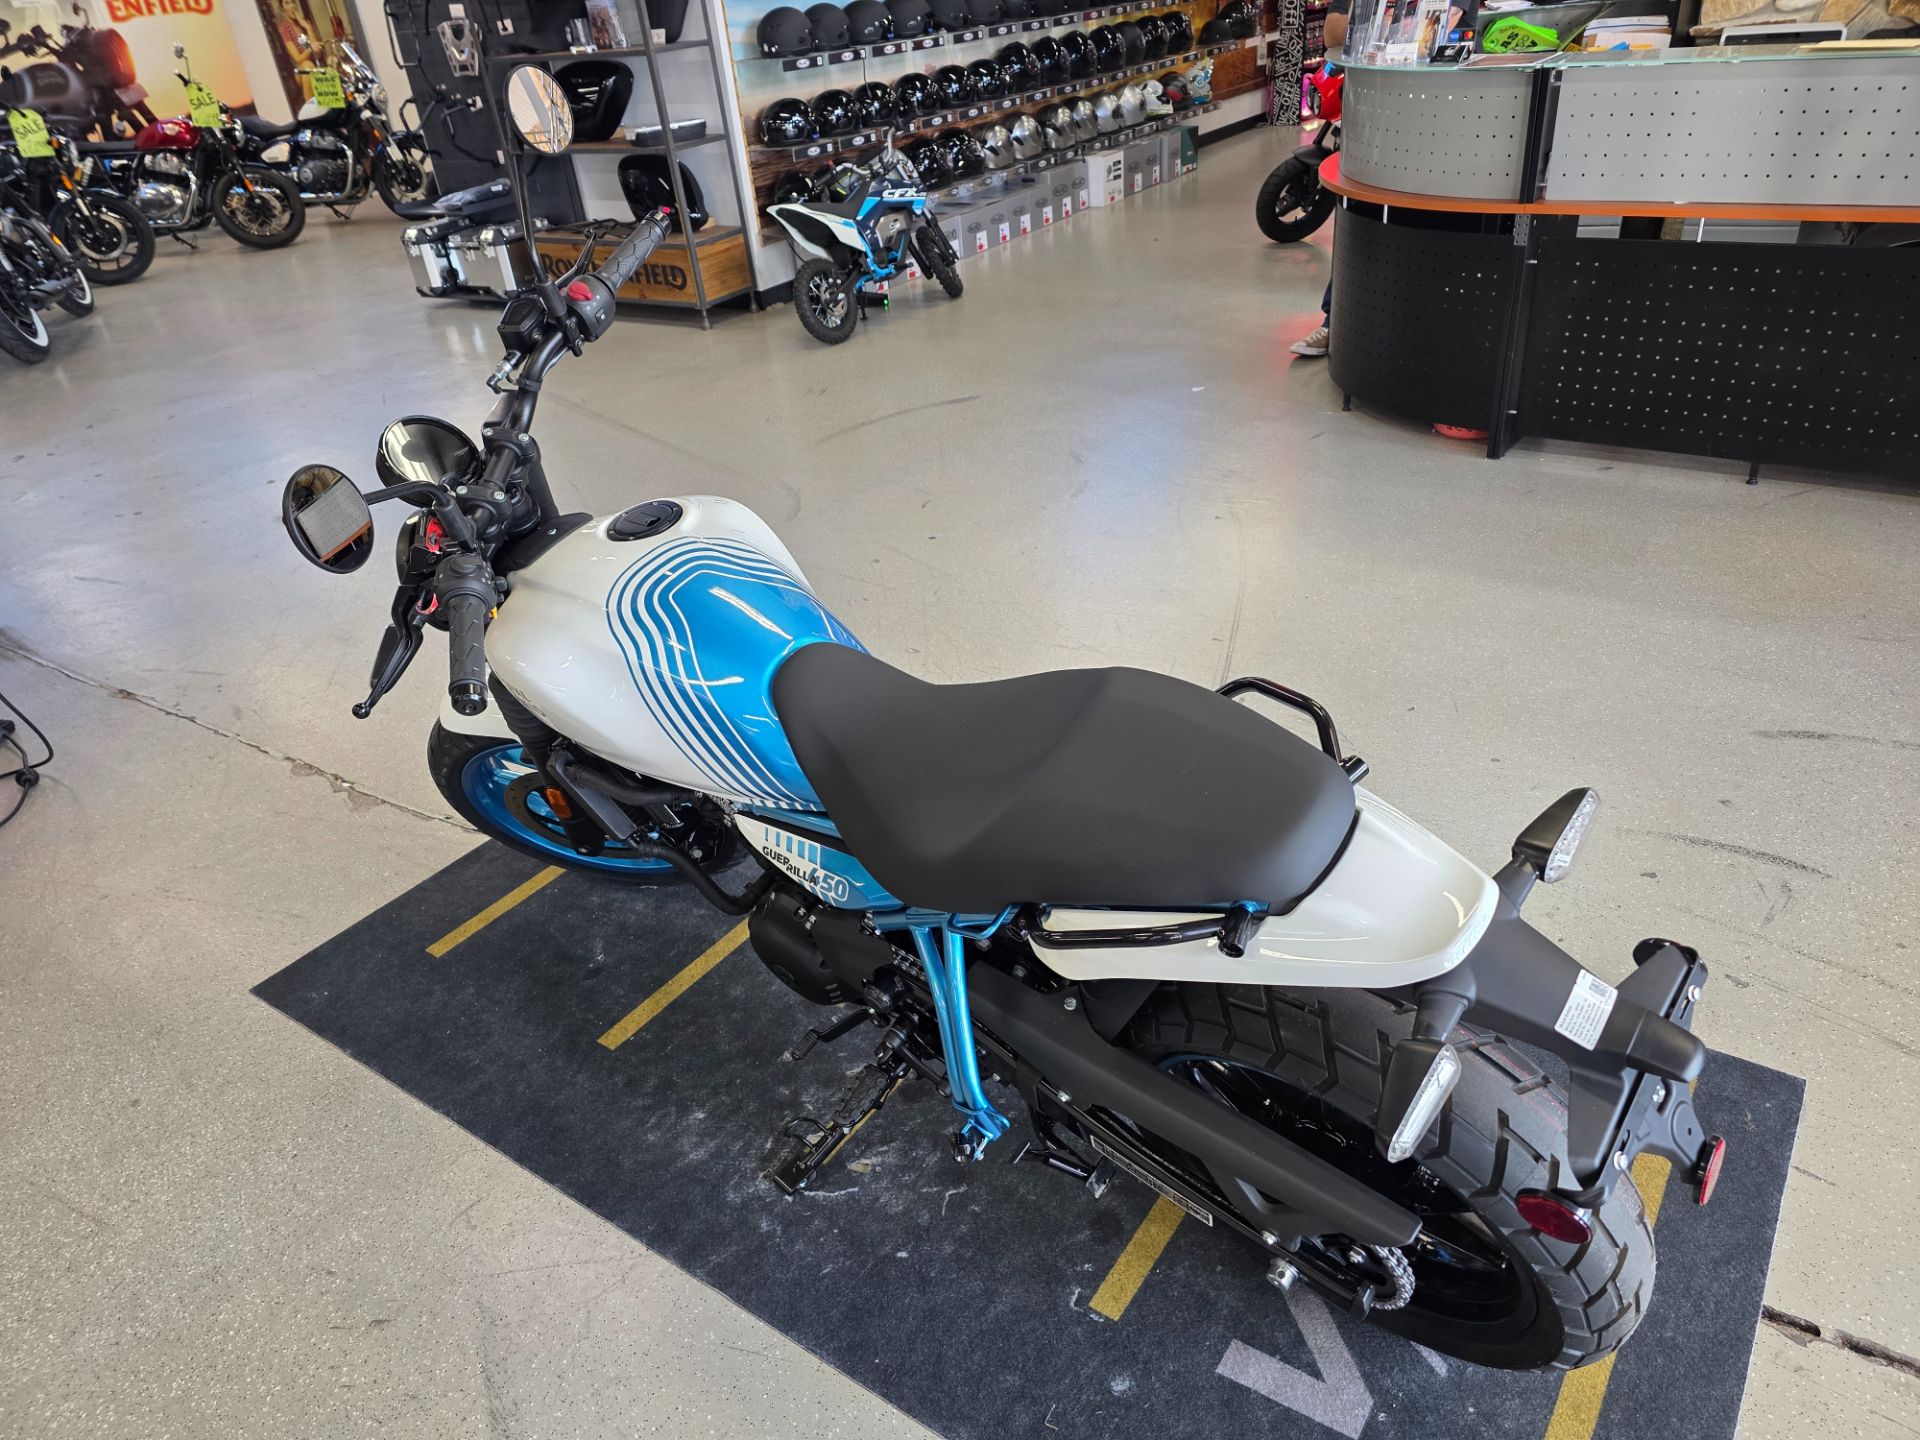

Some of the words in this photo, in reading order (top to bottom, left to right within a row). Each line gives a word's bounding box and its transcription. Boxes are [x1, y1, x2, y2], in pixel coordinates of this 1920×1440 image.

[189, 92, 216, 110] SALE
[15, 118, 44, 140] SALE
[762, 845, 818, 887] GUERRILLA
[807, 867, 849, 901] 450
